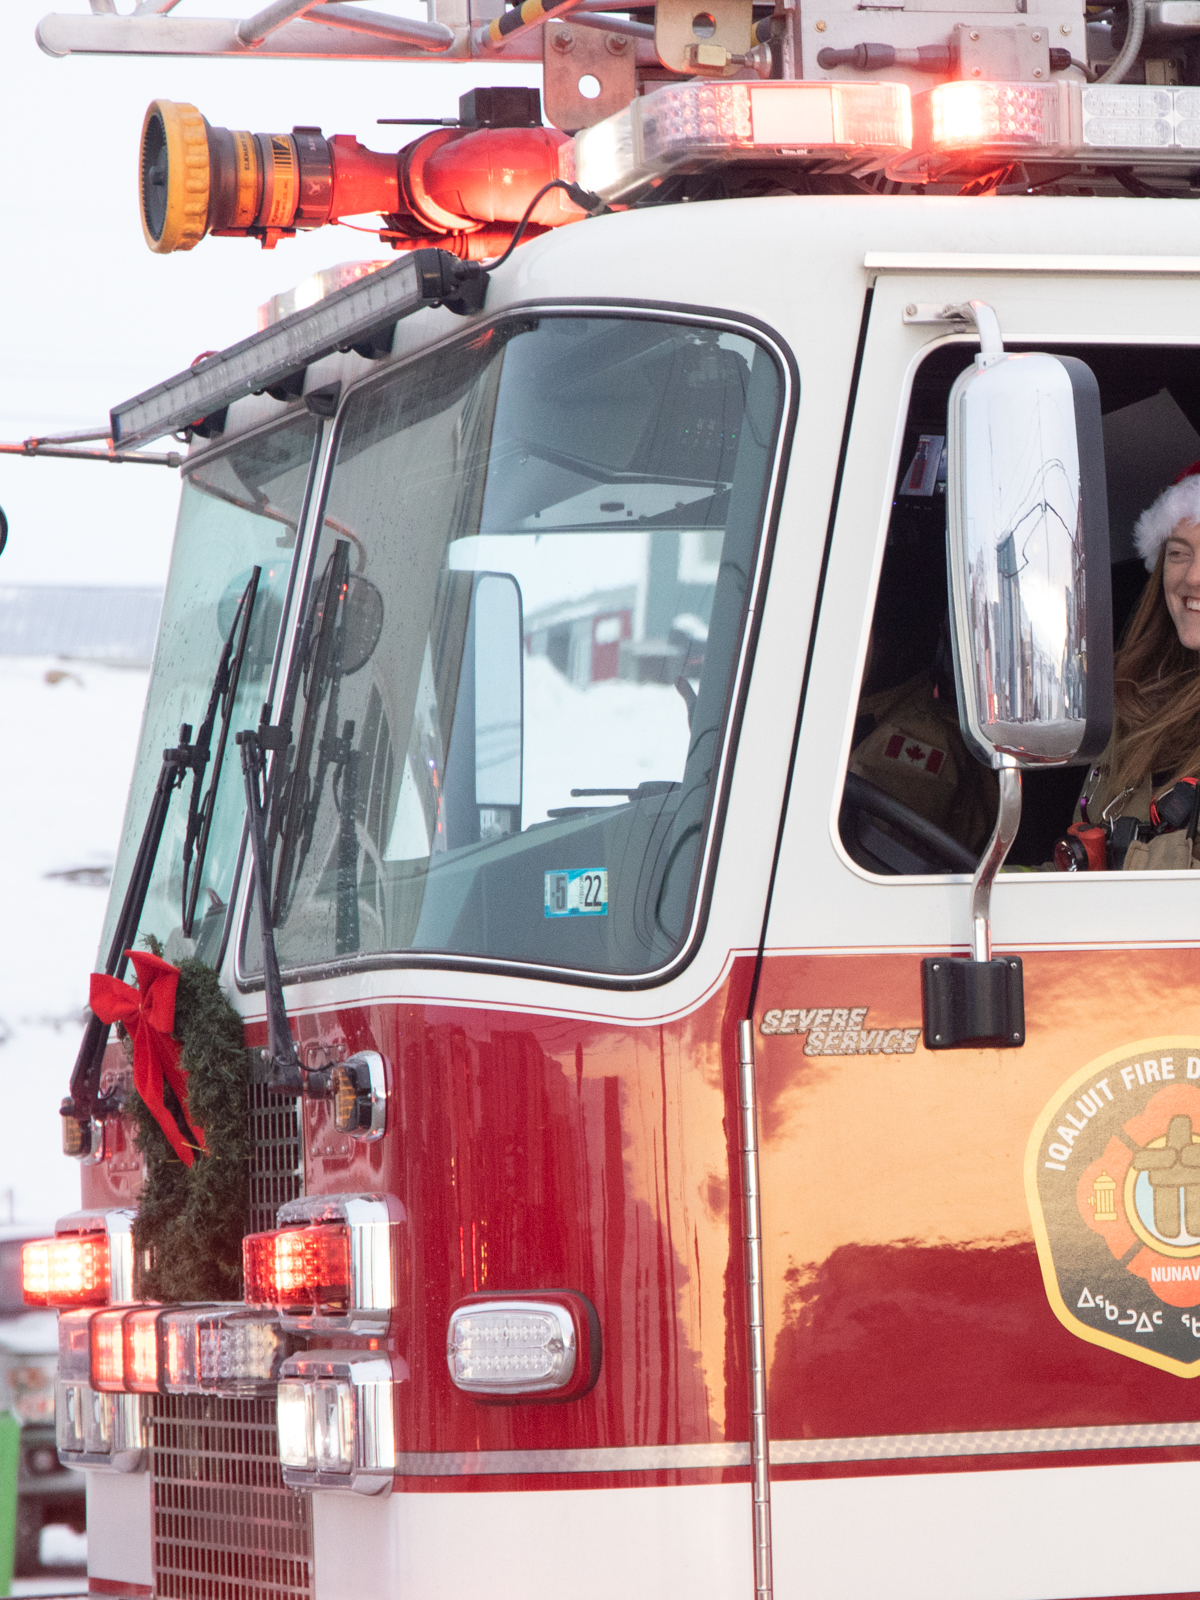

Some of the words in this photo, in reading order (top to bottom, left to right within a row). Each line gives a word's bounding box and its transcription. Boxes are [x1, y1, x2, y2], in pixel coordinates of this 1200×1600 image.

[584, 874, 602, 907] 22
[760, 1006, 869, 1035] SEVERE
[803, 1028, 922, 1057] SERVICE
[1044, 1078, 1114, 1172] IQALUIT
[1120, 1056, 1176, 1091] FIRE
